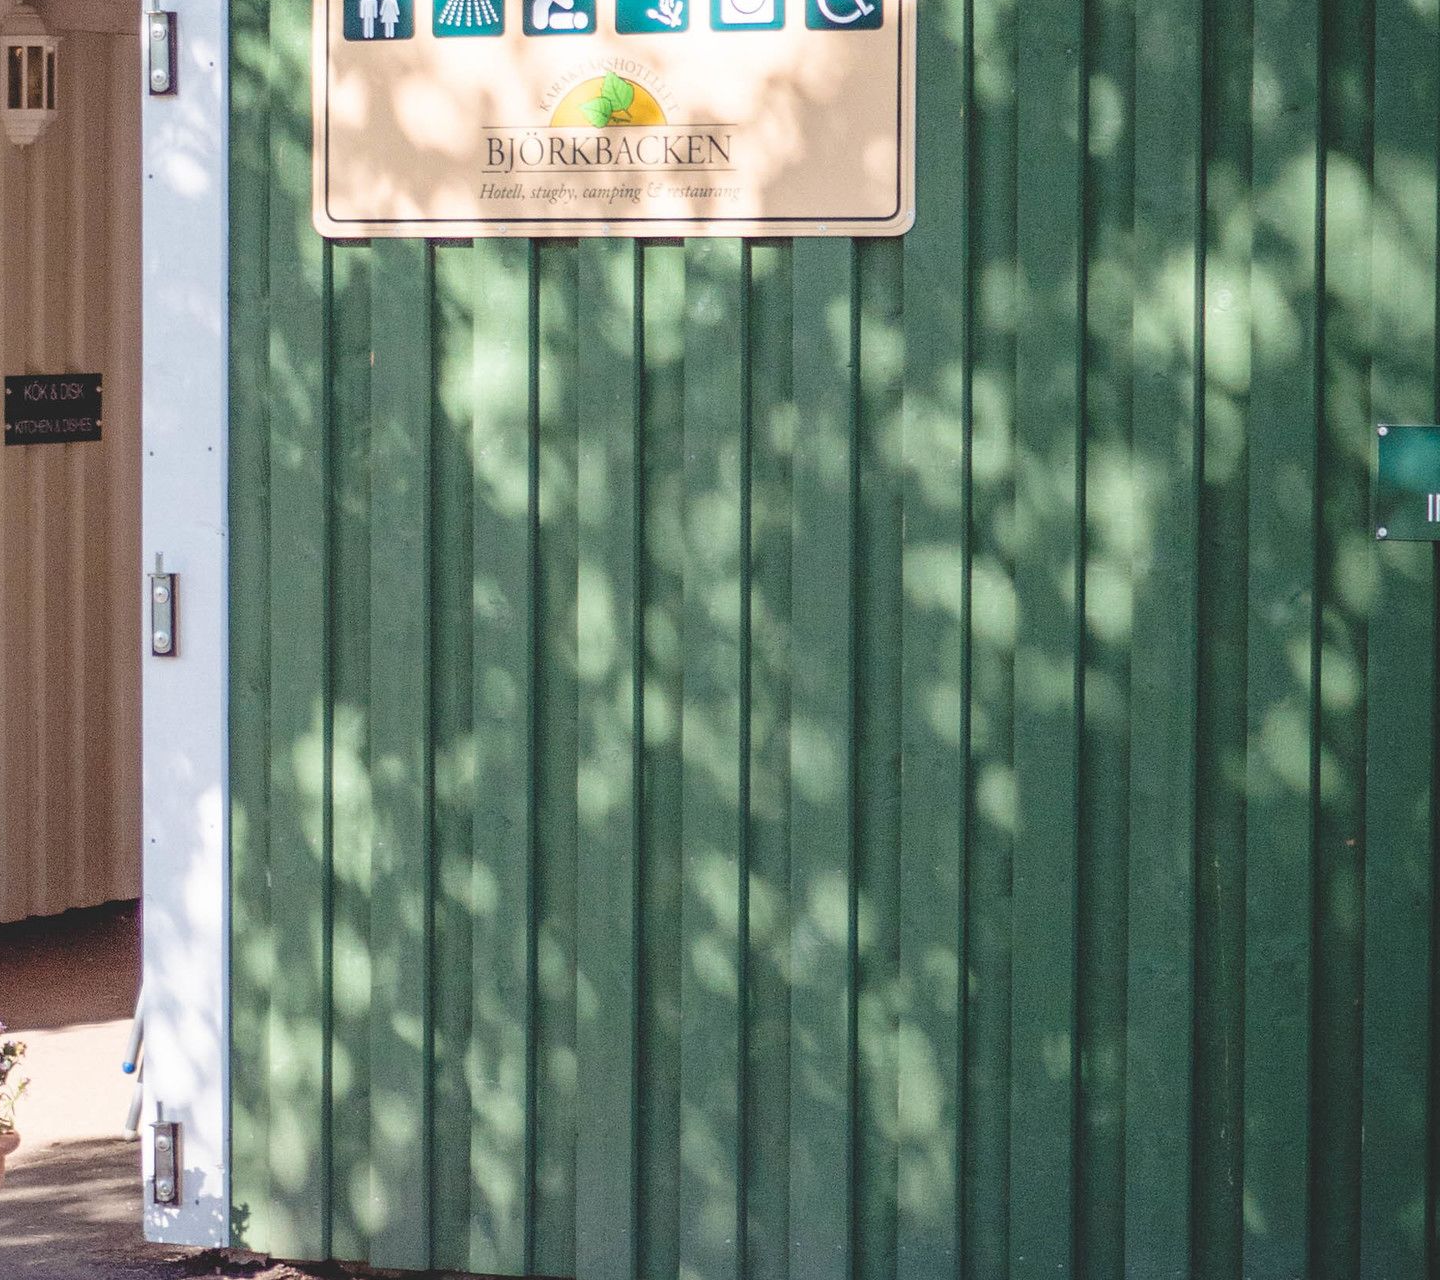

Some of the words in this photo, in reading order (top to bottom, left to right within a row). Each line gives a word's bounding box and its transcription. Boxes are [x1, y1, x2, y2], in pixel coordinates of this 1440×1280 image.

[487, 131, 732, 174] BJÖRKBACKEN
[479, 183, 526, 201] Hotell,
[530, 183, 578, 204] stugby,
[582, 184, 642, 204] camping
